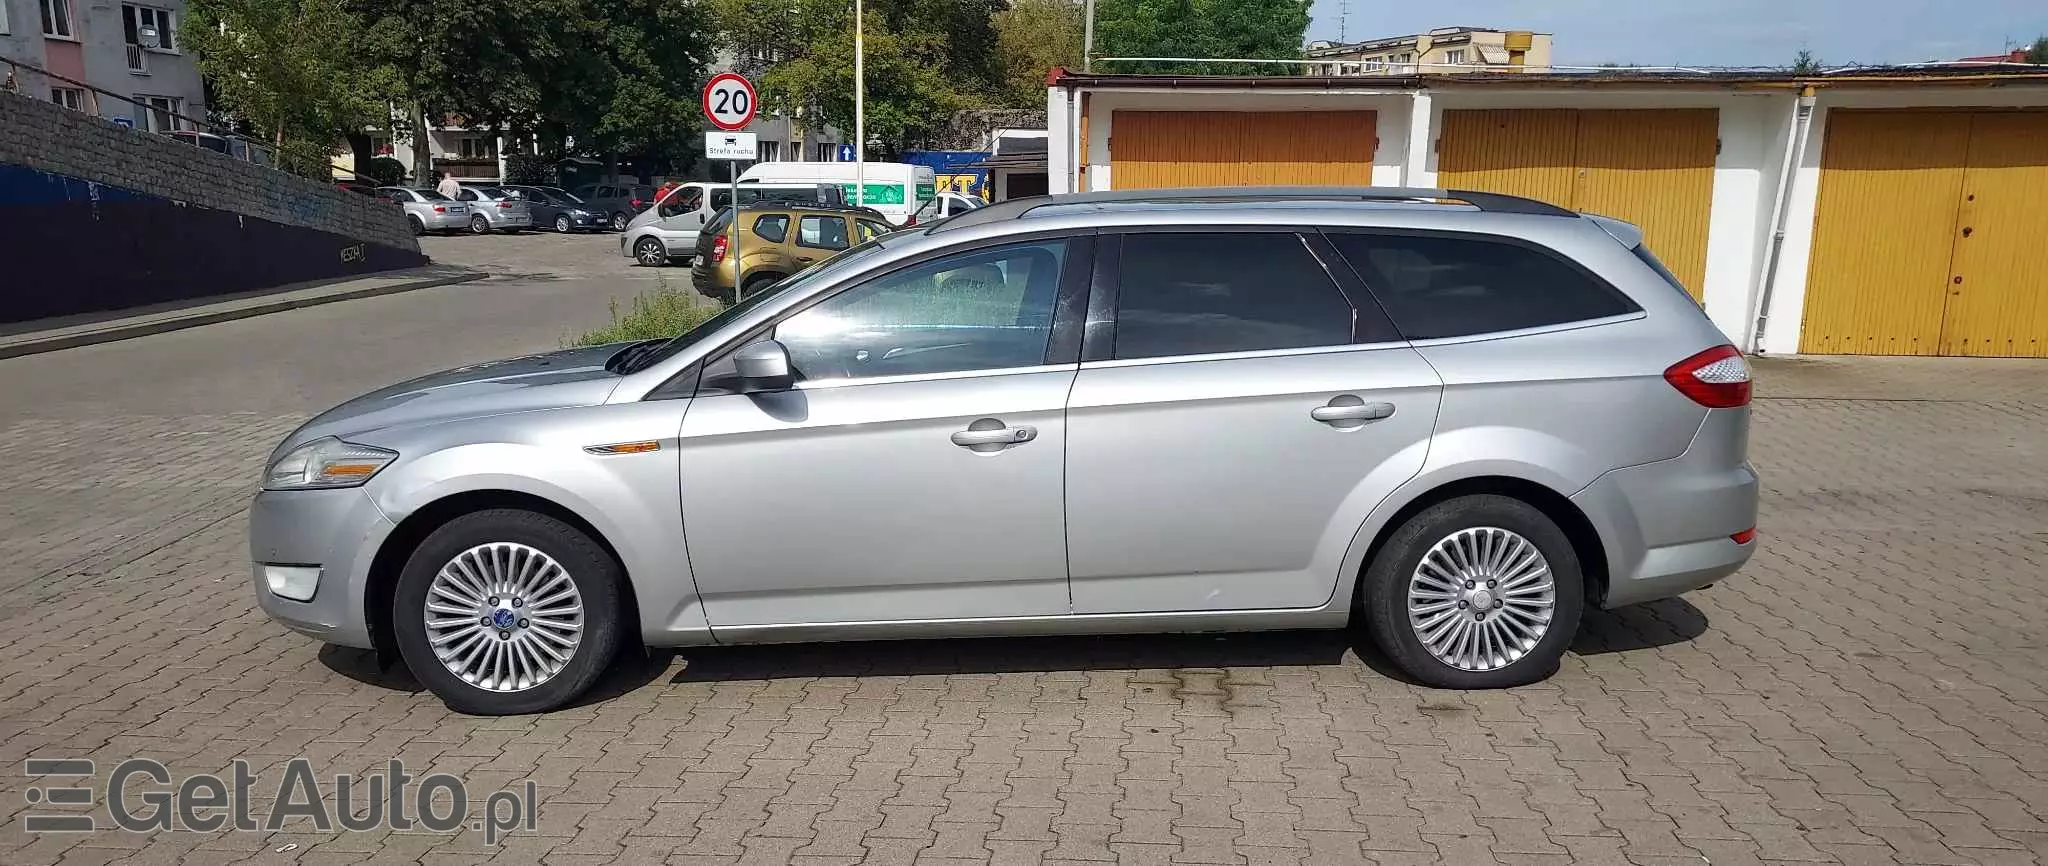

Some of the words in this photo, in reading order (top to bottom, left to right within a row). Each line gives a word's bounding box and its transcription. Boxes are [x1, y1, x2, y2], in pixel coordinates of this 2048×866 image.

[714, 88, 748, 115] 20
[709, 147, 731, 155] Strefa
[733, 147, 754, 155] ruchu
